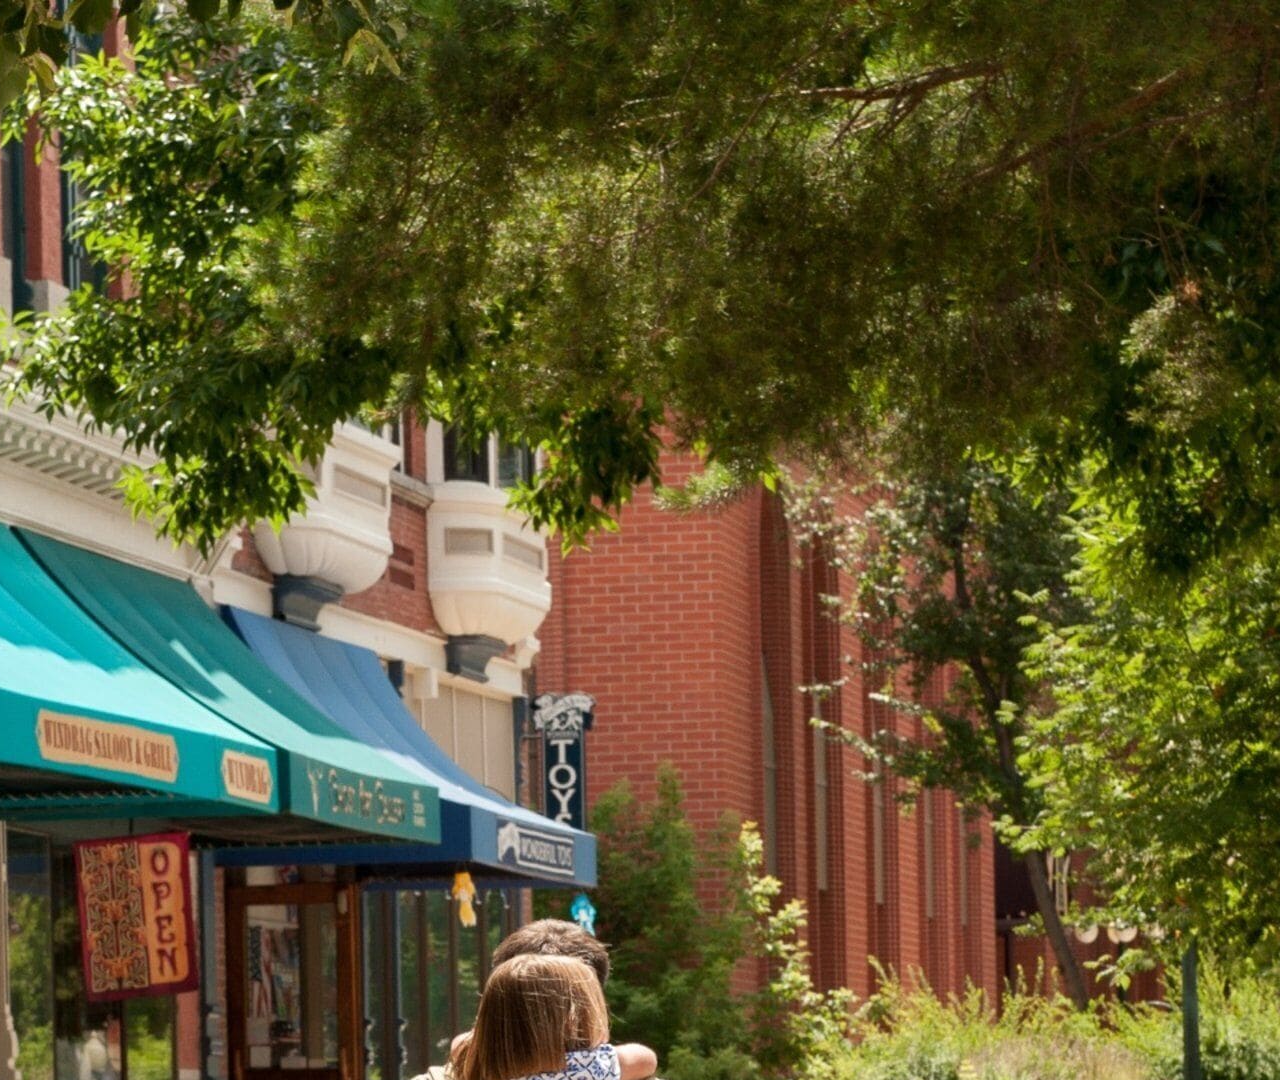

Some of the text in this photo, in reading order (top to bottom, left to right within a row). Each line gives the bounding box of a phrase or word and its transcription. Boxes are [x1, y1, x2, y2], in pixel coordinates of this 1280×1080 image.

[43, 719, 173, 772] WINDBAG SALOON & GRILL
[227, 758, 268, 795] WINDBAG
[150, 848, 178, 977] OPEN
